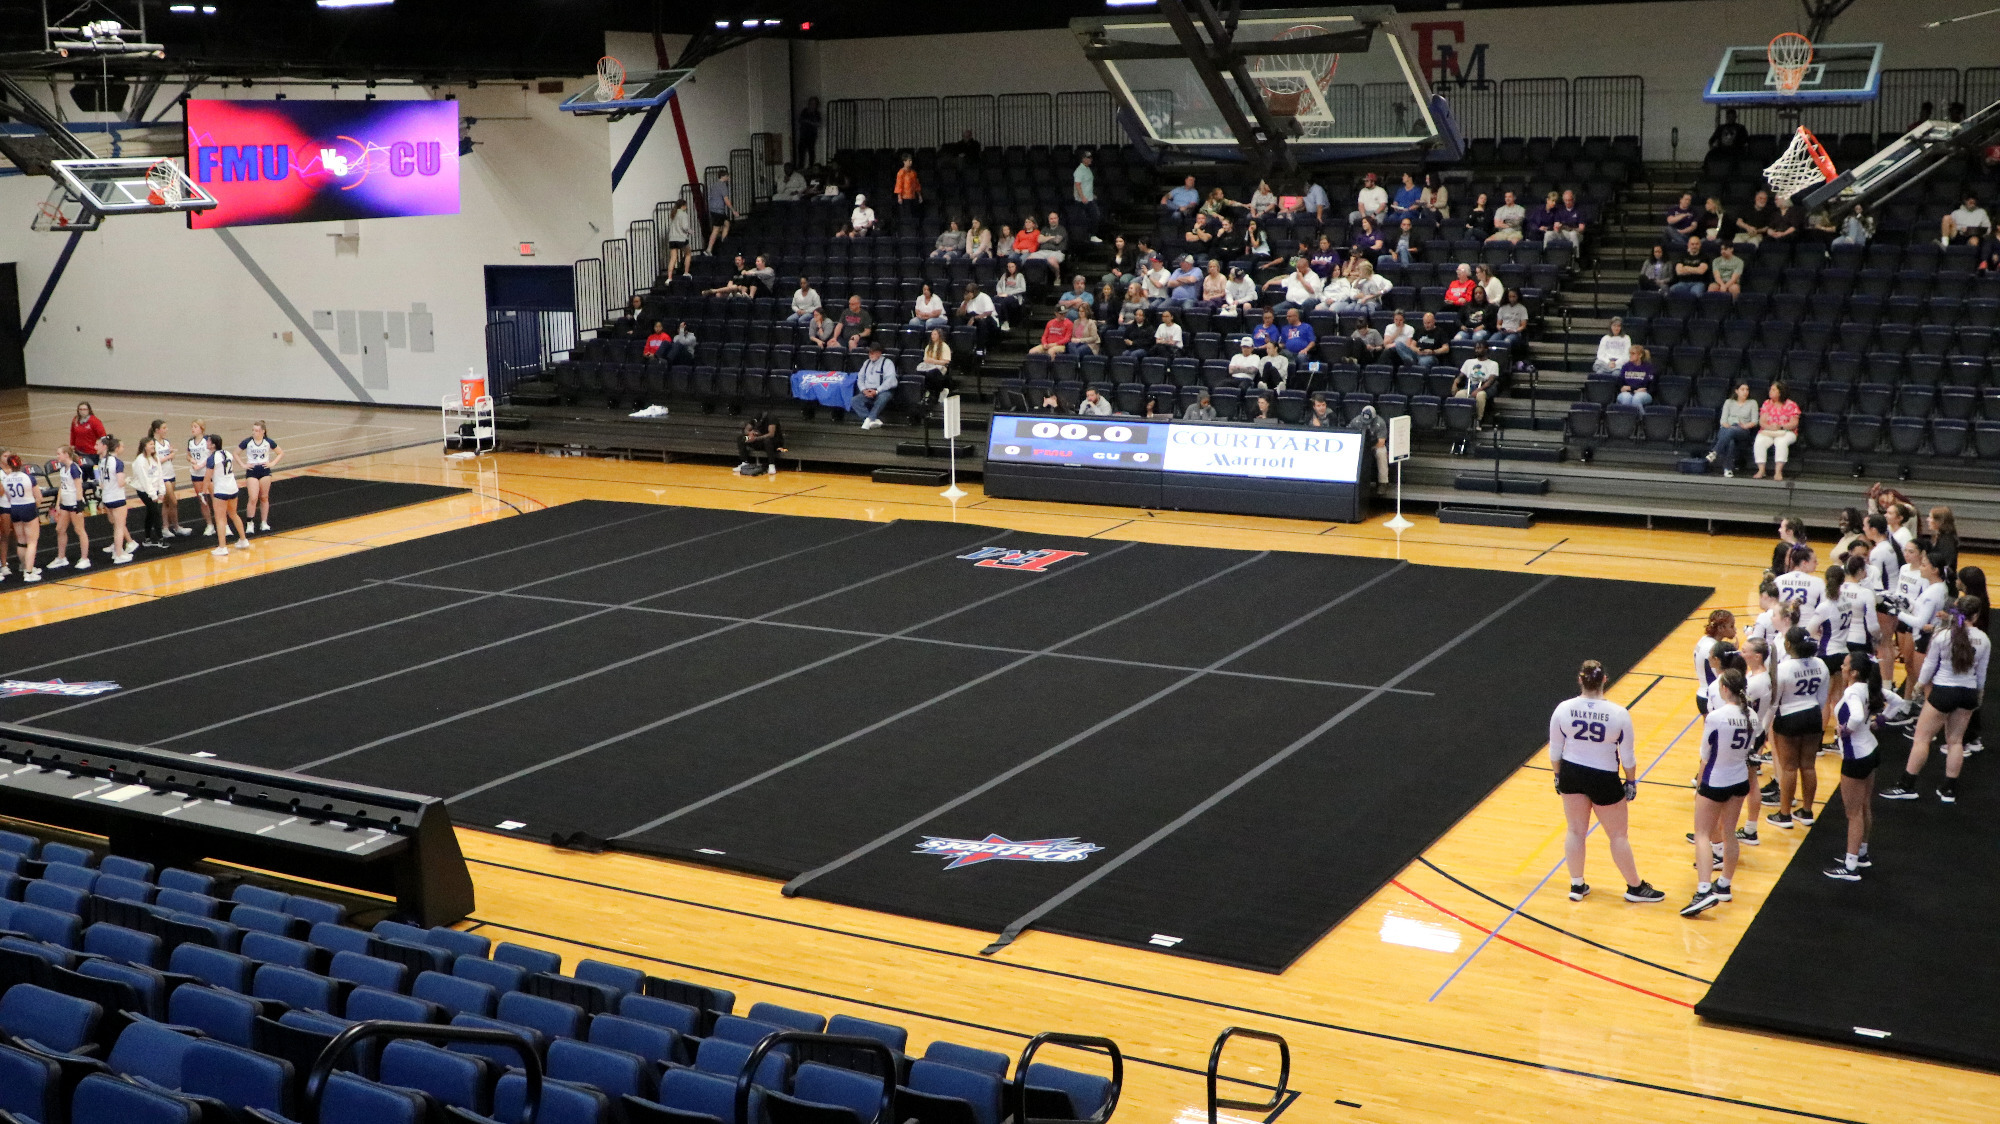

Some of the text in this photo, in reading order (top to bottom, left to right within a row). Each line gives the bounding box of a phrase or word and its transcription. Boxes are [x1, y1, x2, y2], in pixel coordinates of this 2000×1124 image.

[198, 144, 289, 183] FMU
[390, 141, 441, 177] CU
[1031, 422, 1133, 443] 00.0
[1172, 430, 1344, 453] COURTYARD
[1004, 445, 1150, 462] 0 FMU CU 0
[1206, 453, 1295, 469] Marriott
[7, 482, 25, 498] 30
[1782, 587, 1808, 605] 23
[1794, 667, 1822, 679] VALKYRIES
[1794, 677, 1822, 696] 26
[1570, 709, 1610, 722] VALKYRIES
[1571, 719, 1607, 743] 29
[921, 838, 1091, 863] Patriots
